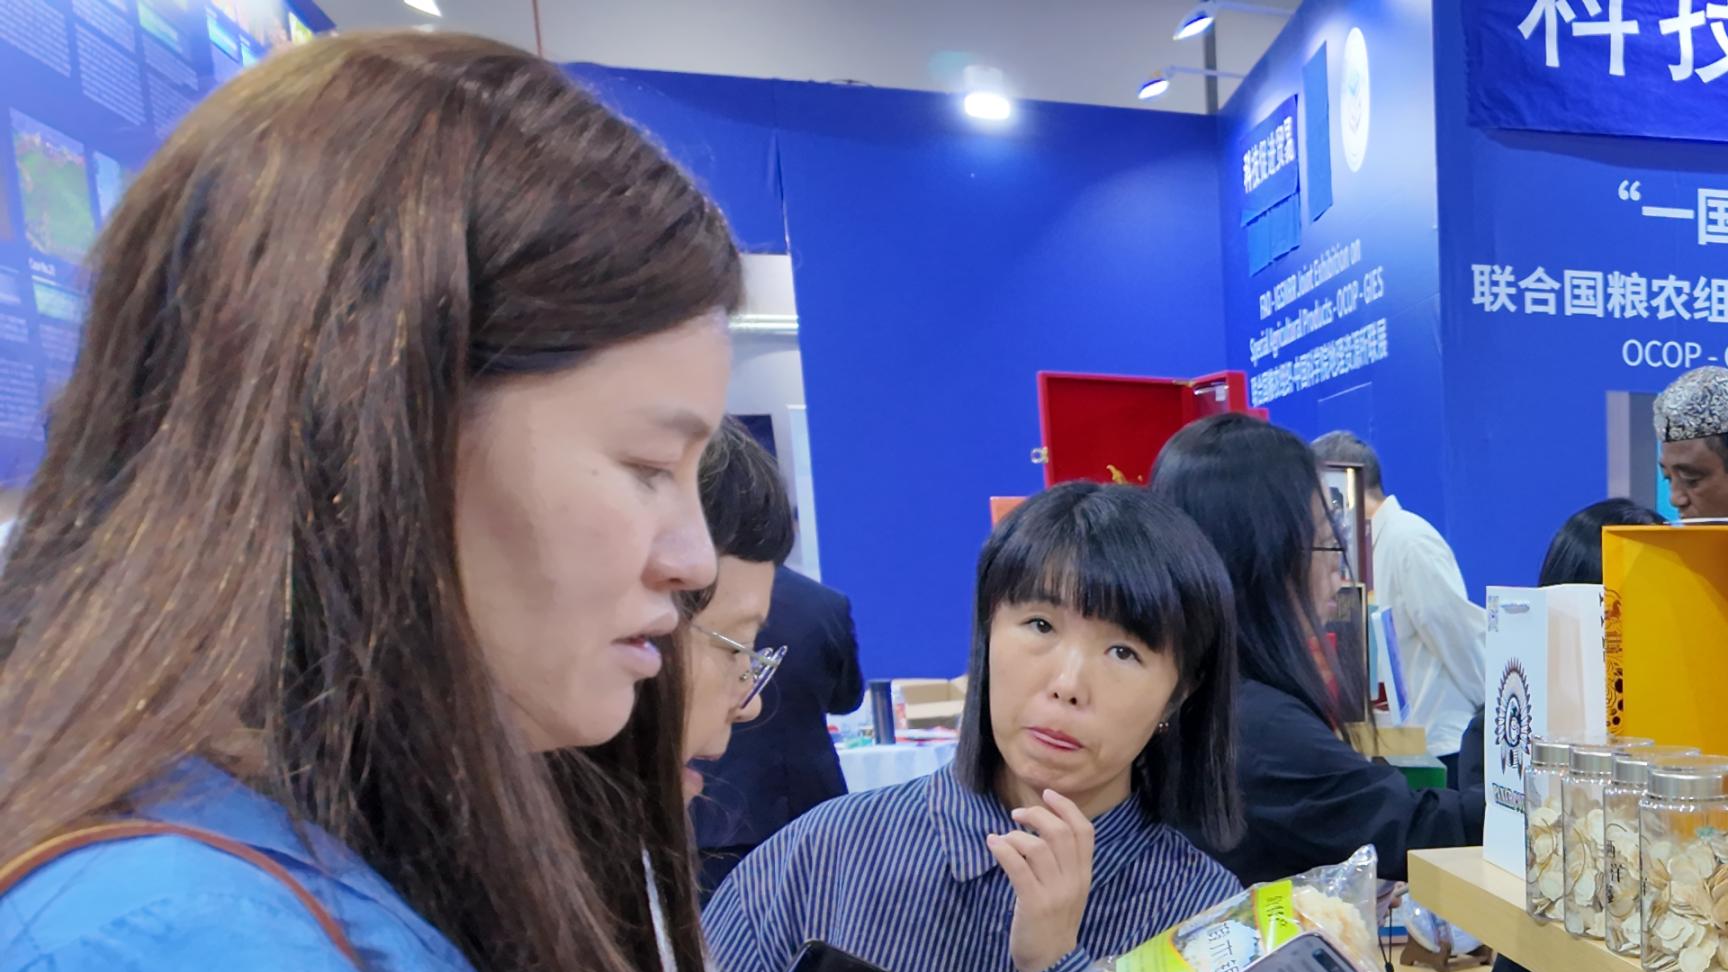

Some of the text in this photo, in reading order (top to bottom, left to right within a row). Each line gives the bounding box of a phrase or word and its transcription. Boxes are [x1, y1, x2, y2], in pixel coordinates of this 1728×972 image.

[1297, 264, 1314, 297] Joint
[1313, 242, 1350, 287] Exhibition
[1350, 238, 1361, 265] on
[1249, 328, 1269, 367] Special
[1301, 298, 1334, 333] Products
[1336, 279, 1359, 319] OCOP
[1363, 265, 1385, 304] GIES
[1621, 338, 1703, 370] OCOP
